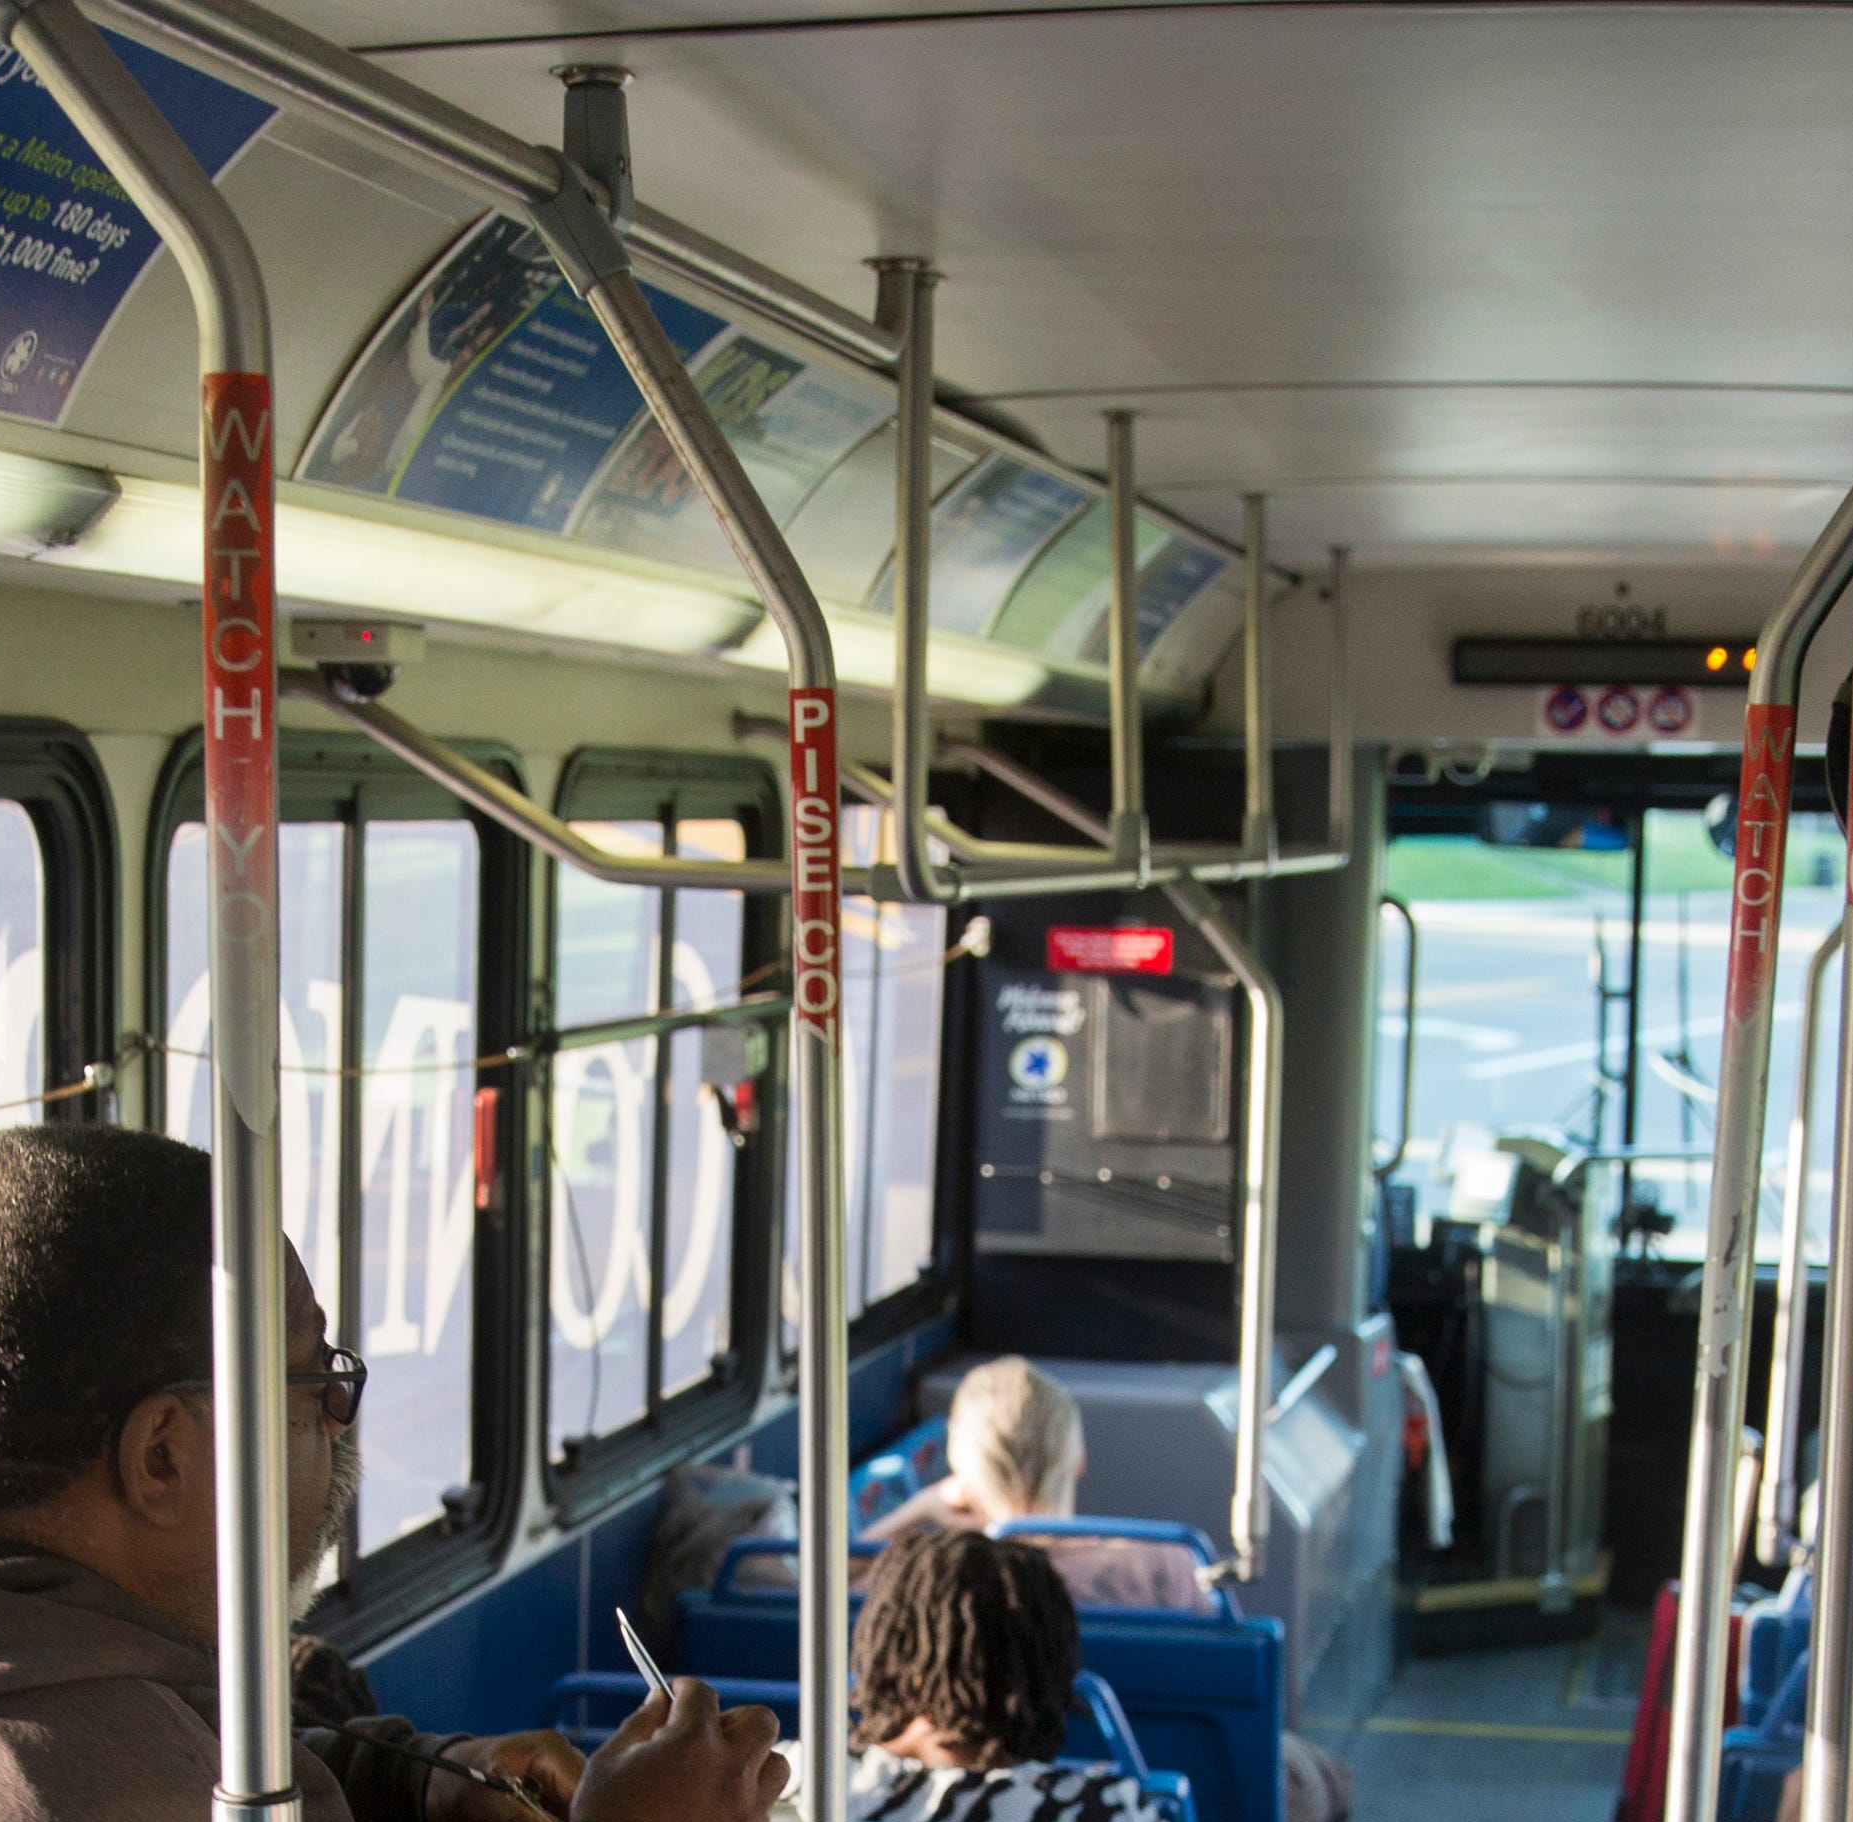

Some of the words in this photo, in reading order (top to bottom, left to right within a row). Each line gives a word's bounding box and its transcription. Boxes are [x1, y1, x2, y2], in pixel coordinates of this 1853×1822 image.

[1, 137, 20, 160] a
[17, 135, 73, 179] Metro
[2, 189, 32, 222] up
[29, 194, 51, 222] to
[51, 199, 94, 235] 180
[85, 211, 132, 253] days
[48, 246, 100, 286] fine?
[203, 407, 269, 741] WATCH
[794, 698, 833, 892] PISE
[1733, 724, 1792, 957] WATCH
